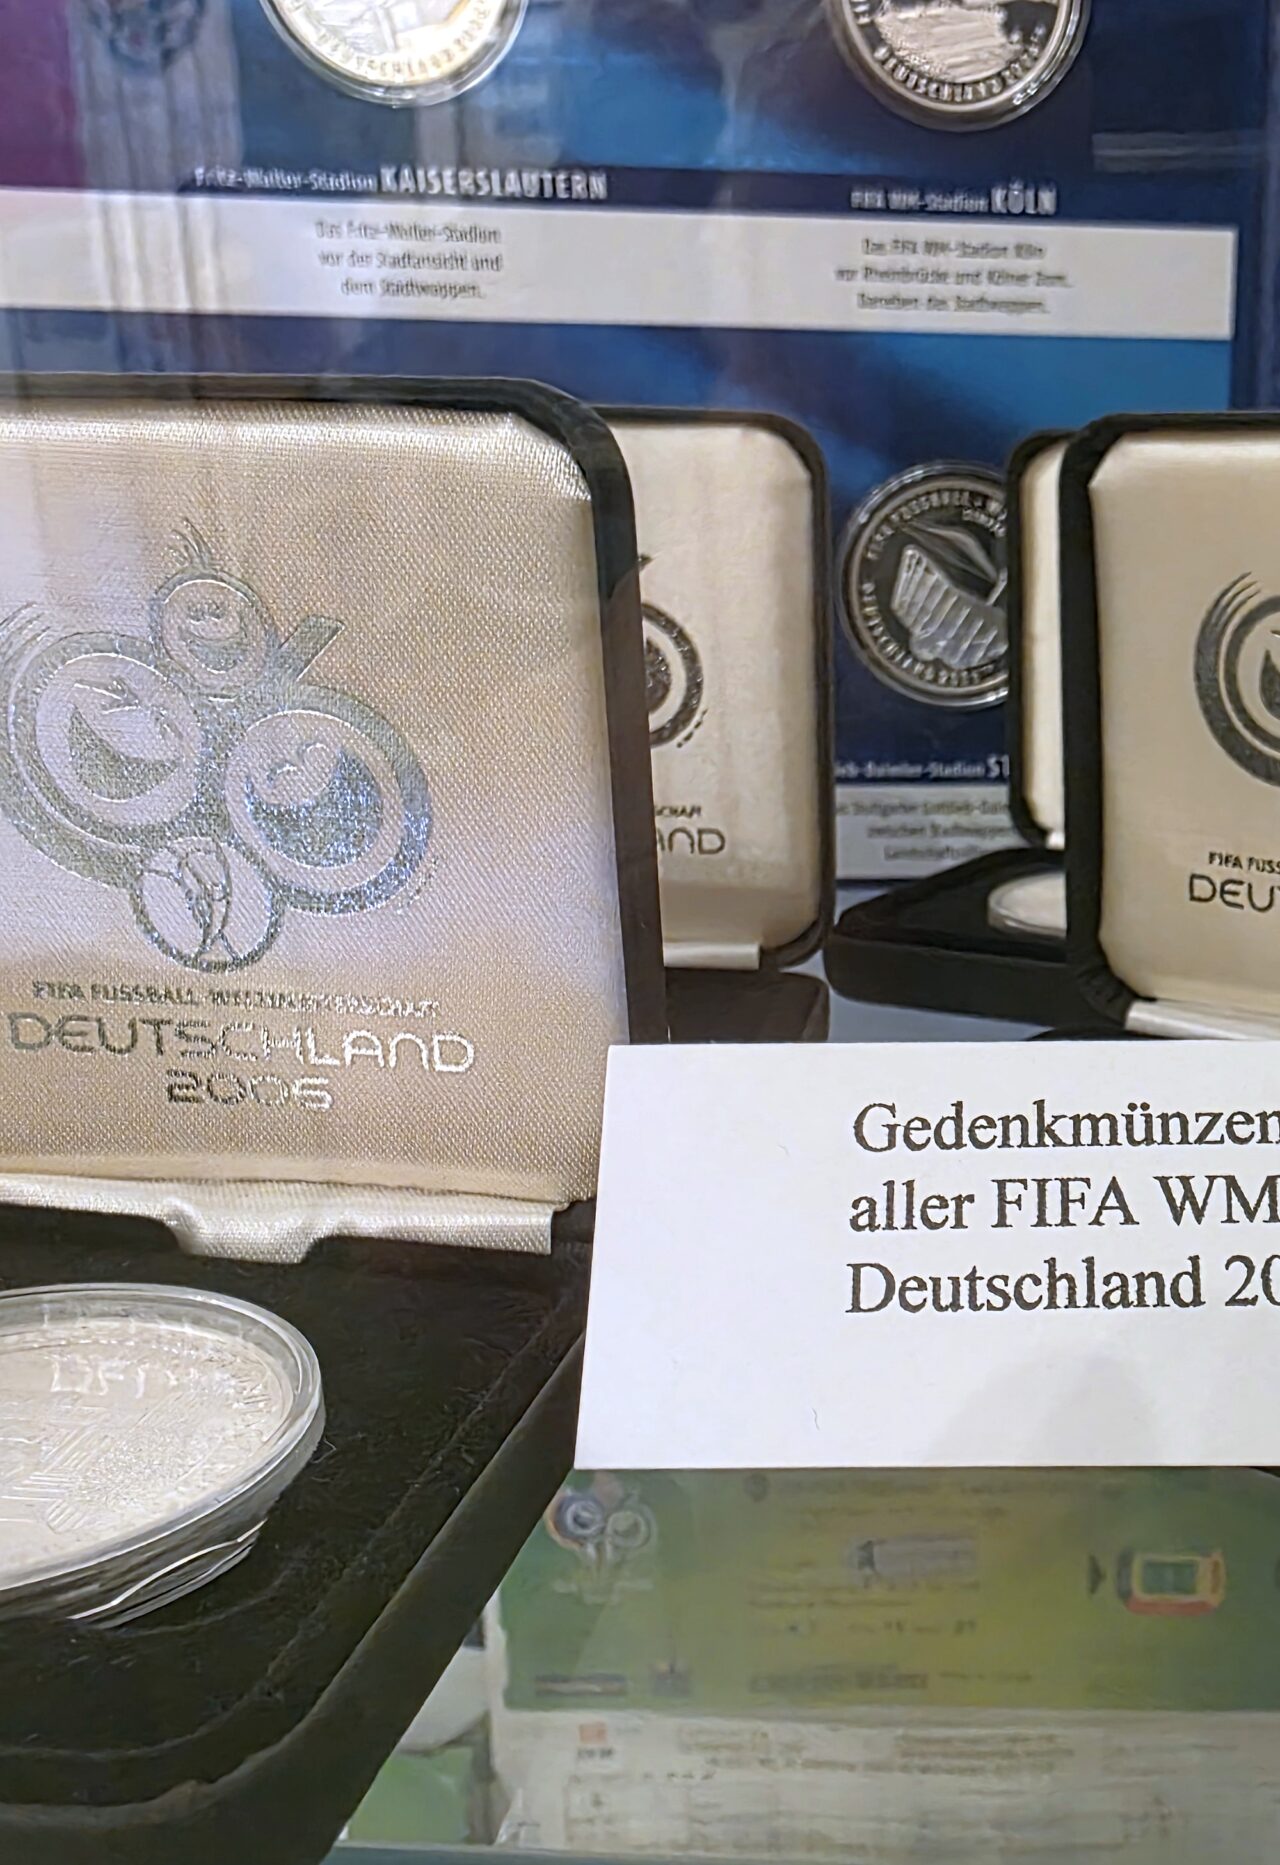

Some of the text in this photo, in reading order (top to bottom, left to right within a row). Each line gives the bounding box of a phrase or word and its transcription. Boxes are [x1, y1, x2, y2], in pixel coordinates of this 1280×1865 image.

[379, 164, 608, 200] KAISERSLAUTERN
[990, 179, 1057, 215] KÖLN
[1208, 851, 1243, 870] FIFA
[8, 1010, 475, 1074] DEUTSCHLAND
[849, 1178, 975, 1232] aller
[990, 1176, 1139, 1229] FIFA
[845, 1255, 1206, 1314] Deutschland
